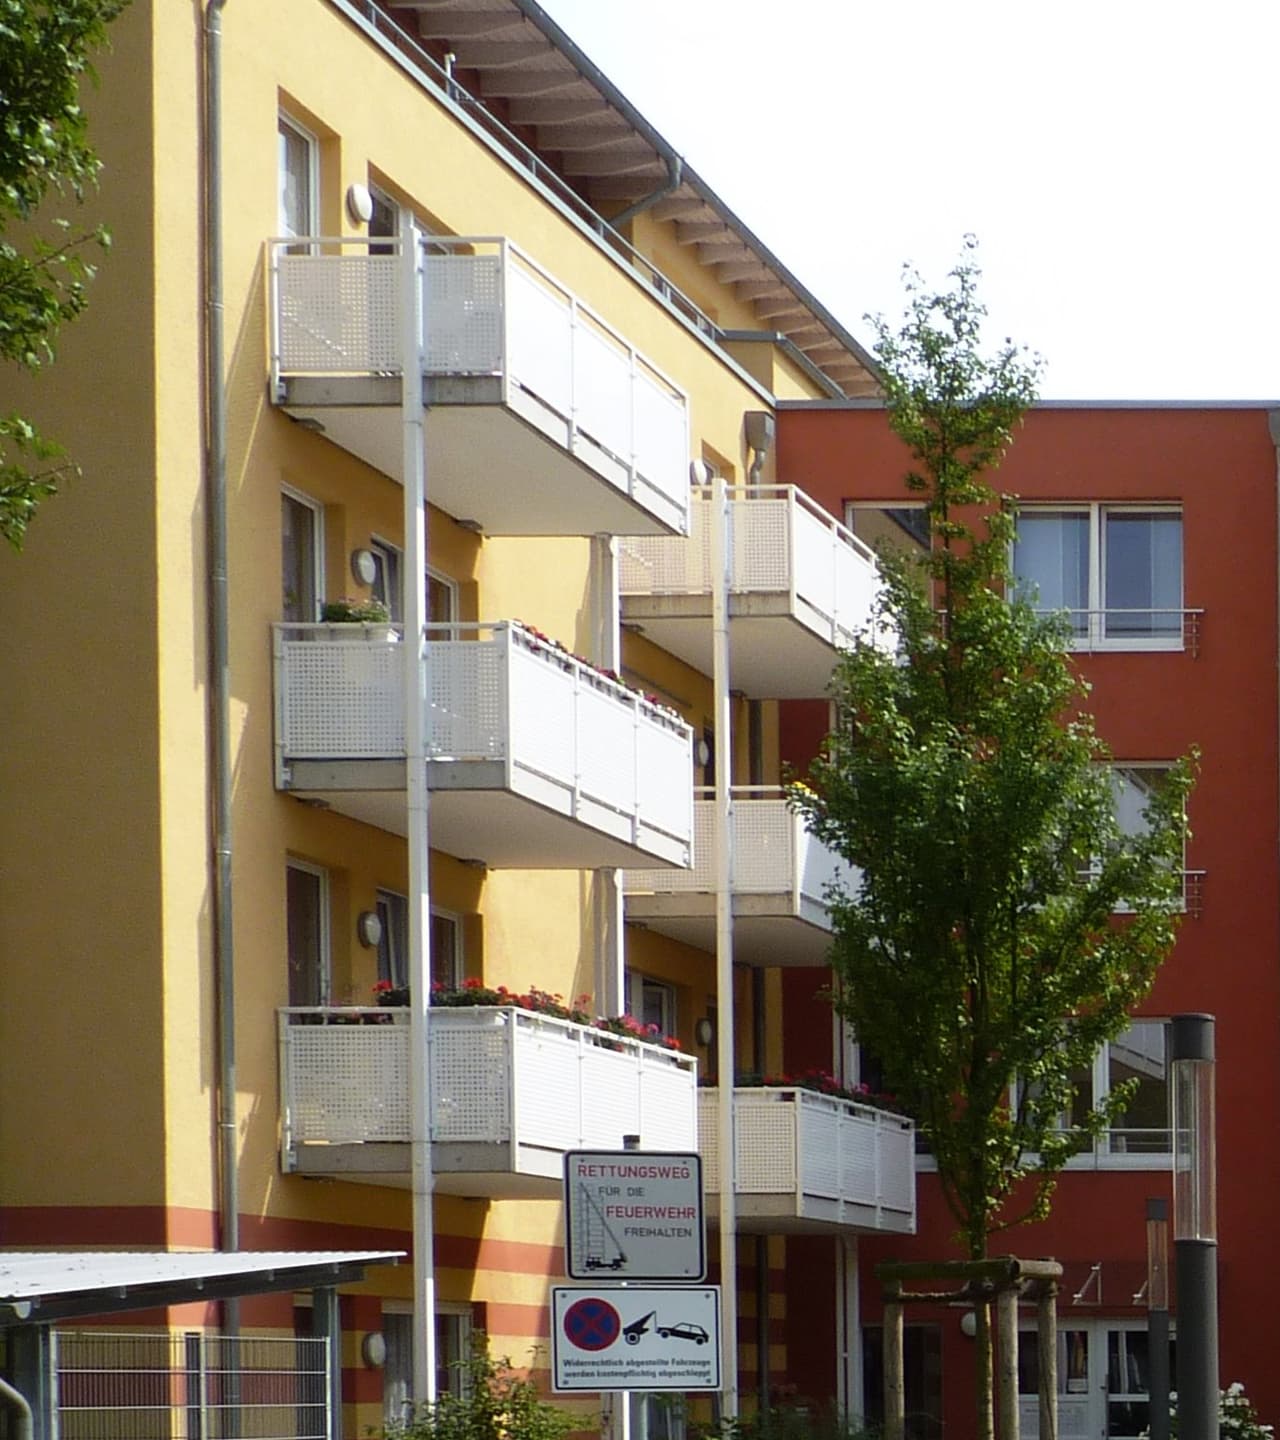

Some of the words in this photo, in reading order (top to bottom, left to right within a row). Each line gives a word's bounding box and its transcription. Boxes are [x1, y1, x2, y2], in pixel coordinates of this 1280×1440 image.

[578, 1164, 690, 1179] RETTUNGSWEG
[627, 1186, 646, 1197] DIE
[606, 1205, 697, 1219] FEUERWEHR
[624, 1226, 693, 1238] FREIHALTEN
[563, 1358, 624, 1367] Widerrechtlich
[626, 1358, 669, 1368] abgestellte
[671, 1358, 711, 1368] Fahrzeuge
[564, 1370, 595, 1378] werden
[597, 1369, 657, 1379] kostenpflichtig
[658, 1369, 711, 1379] abgeschleppt
